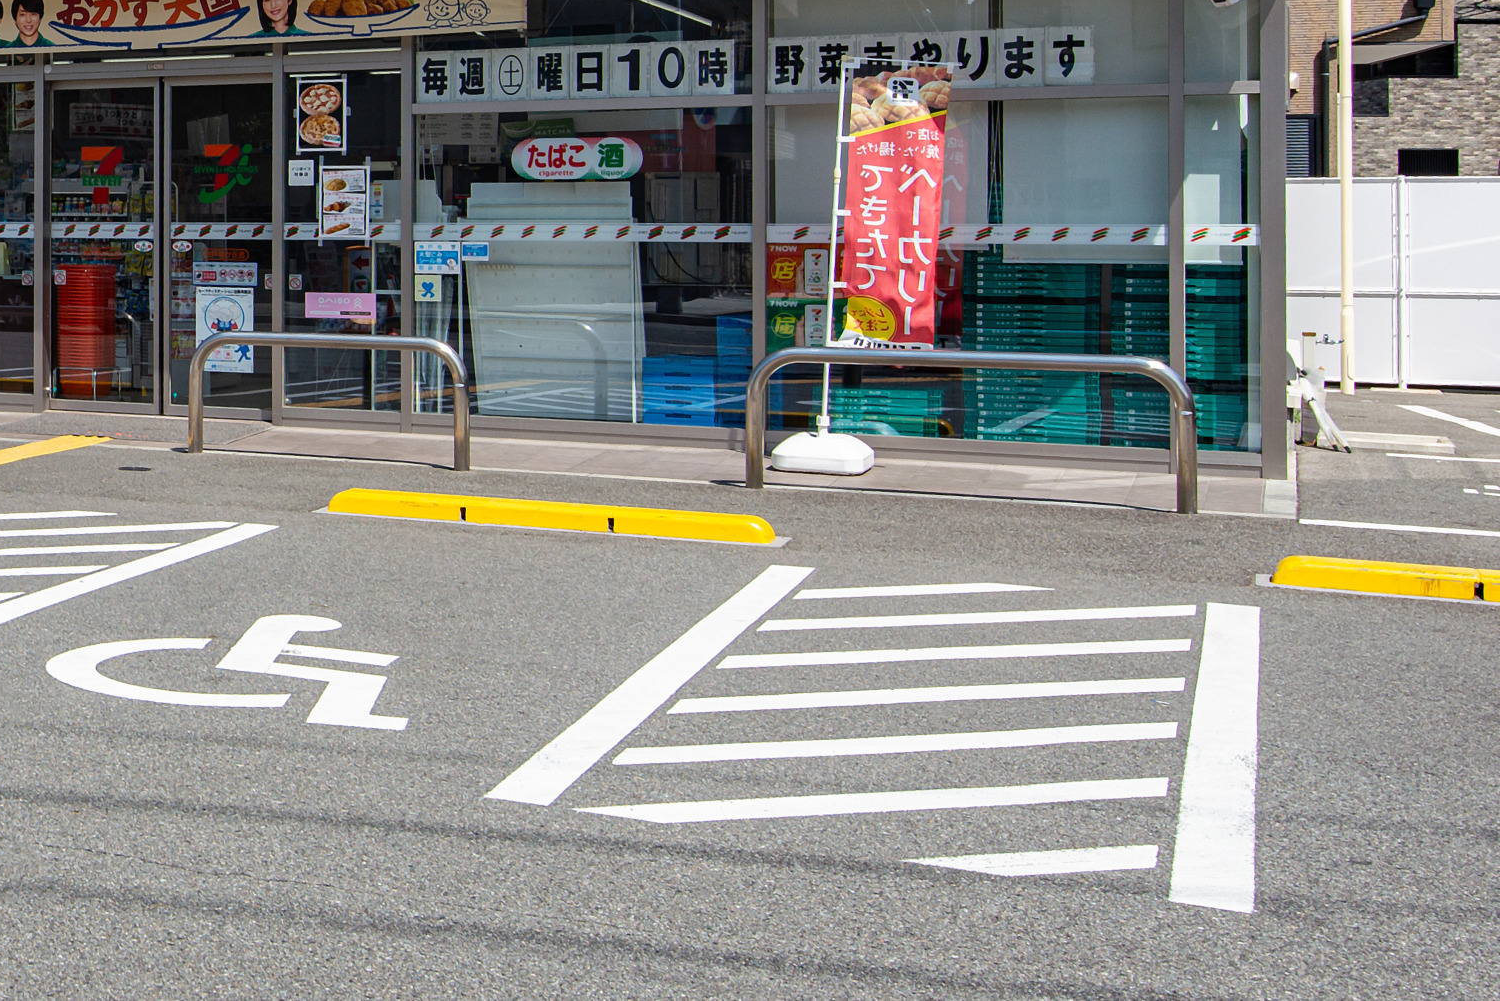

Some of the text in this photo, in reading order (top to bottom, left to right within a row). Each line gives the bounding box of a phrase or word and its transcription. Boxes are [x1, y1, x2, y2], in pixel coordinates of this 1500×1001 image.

[534, 127, 572, 137] MATCHA
[528, 143, 625, 169] たばこ 酒
[538, 169, 625, 177] cigarette liquor
[772, 261, 797, 280] 店
